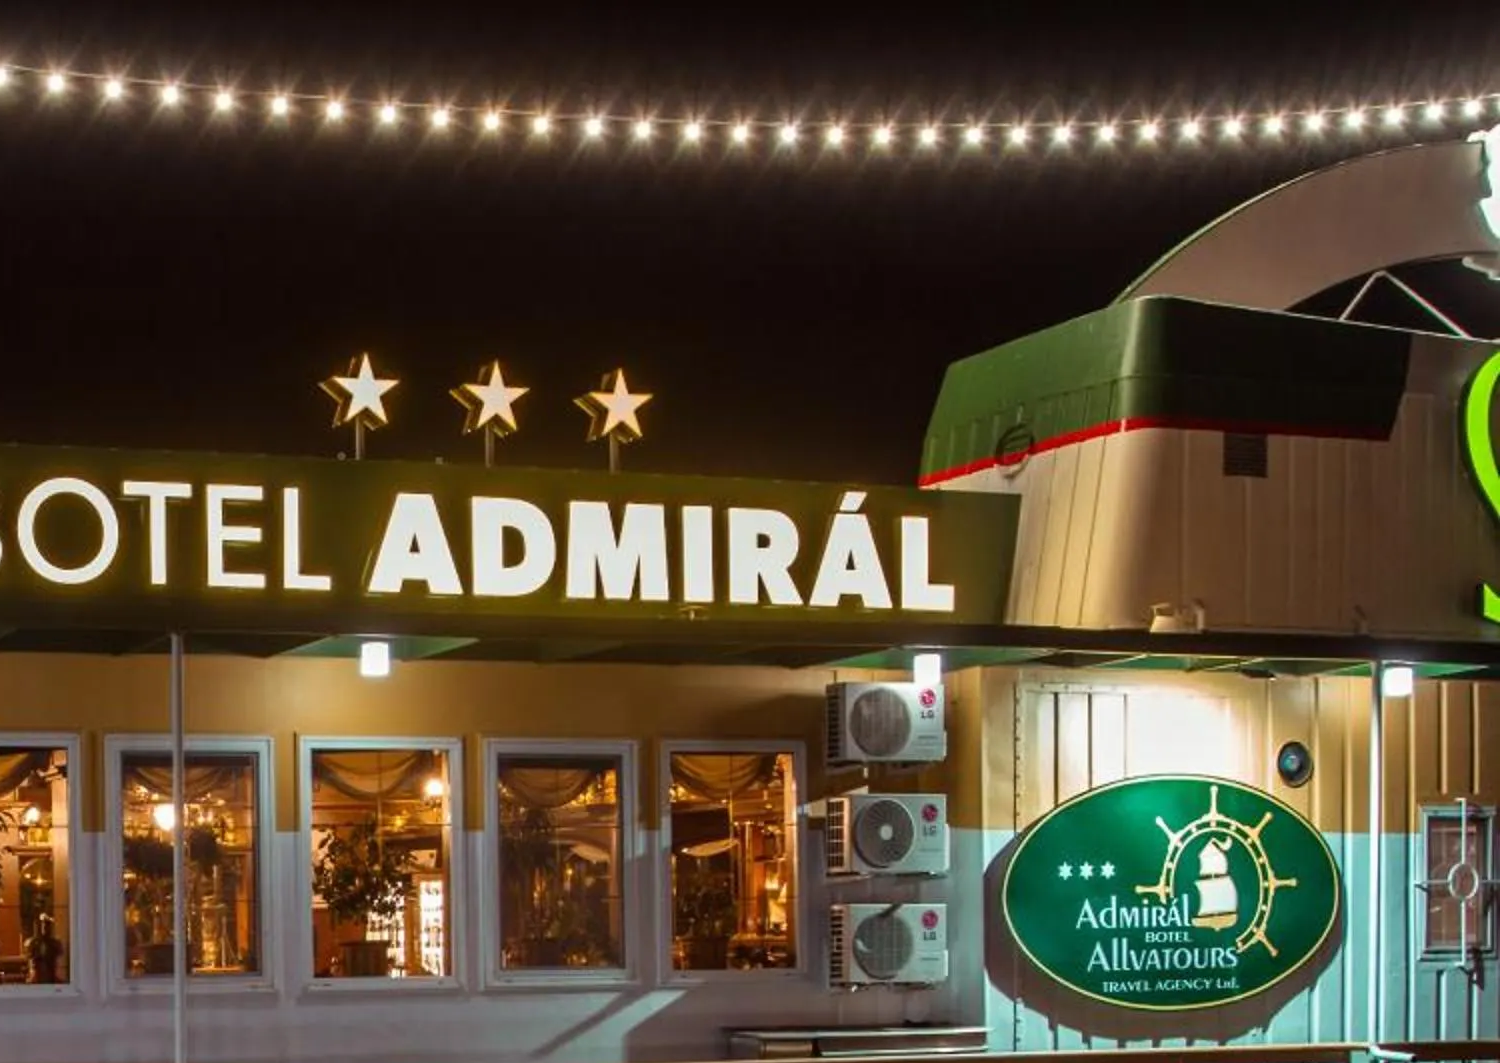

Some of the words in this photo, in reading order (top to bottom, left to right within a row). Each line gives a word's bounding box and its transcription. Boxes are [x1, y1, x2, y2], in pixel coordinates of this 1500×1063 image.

[368, 491, 955, 612] ADMIRÁL
[1145, 931, 1193, 943] BOTEL
[1102, 980, 1151, 993] TRAVEL
[1155, 978, 1213, 992] AGENCY
